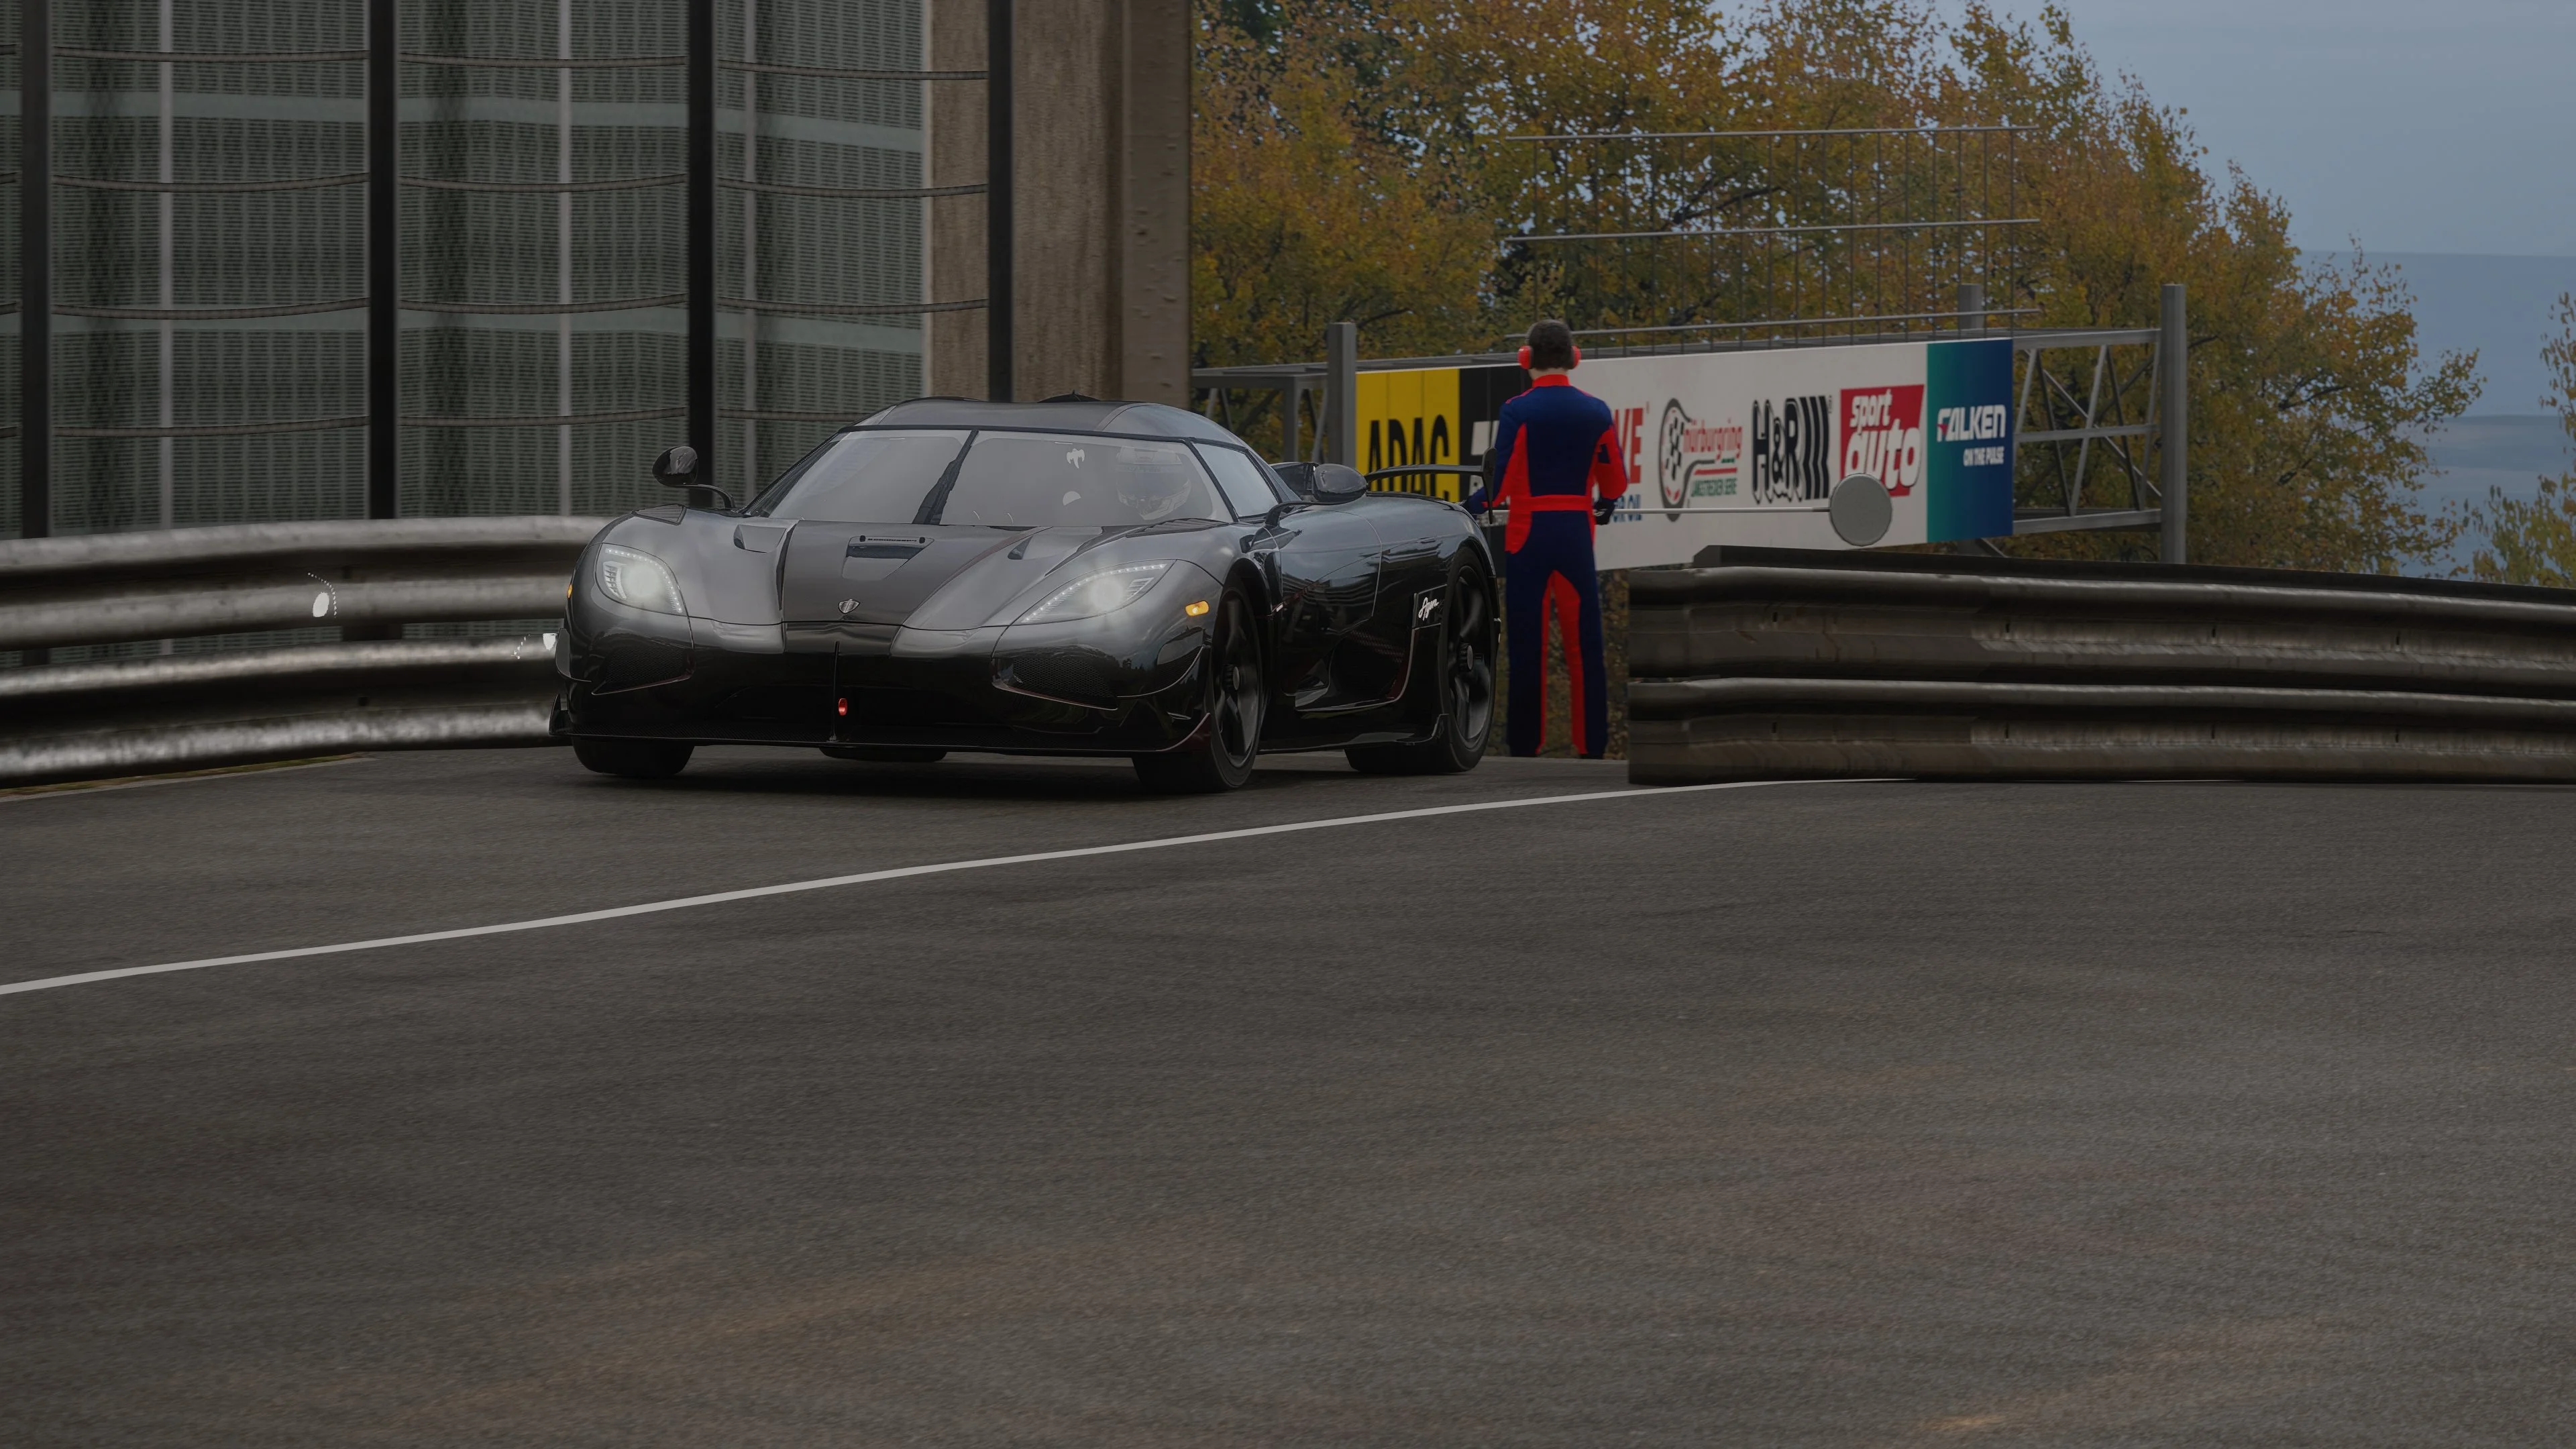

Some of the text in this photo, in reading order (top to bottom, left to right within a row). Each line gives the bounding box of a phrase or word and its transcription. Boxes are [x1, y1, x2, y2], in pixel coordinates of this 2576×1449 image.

[1849, 388, 1893, 434] sport
[1936, 404, 2006, 443] FALKEN
[1368, 414, 1450, 501] ADAC
[1843, 419, 1921, 490] auto
[1986, 446, 2005, 464] PULSE
